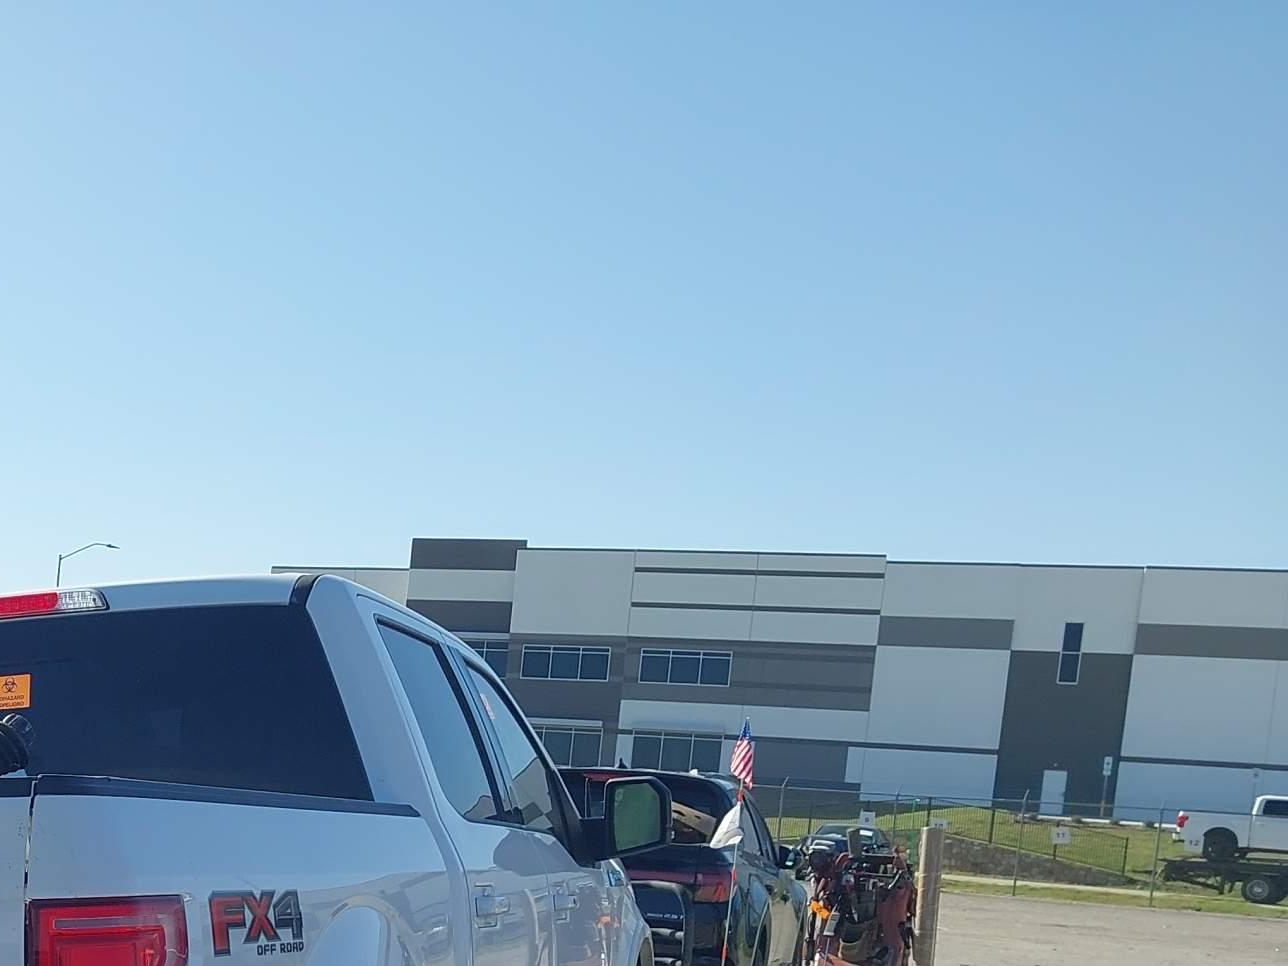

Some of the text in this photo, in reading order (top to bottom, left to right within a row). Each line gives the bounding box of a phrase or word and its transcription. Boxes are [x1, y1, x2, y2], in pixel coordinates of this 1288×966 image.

[208, 890, 303, 957] FX4
[257, 941, 304, 956] OFF ROAD
